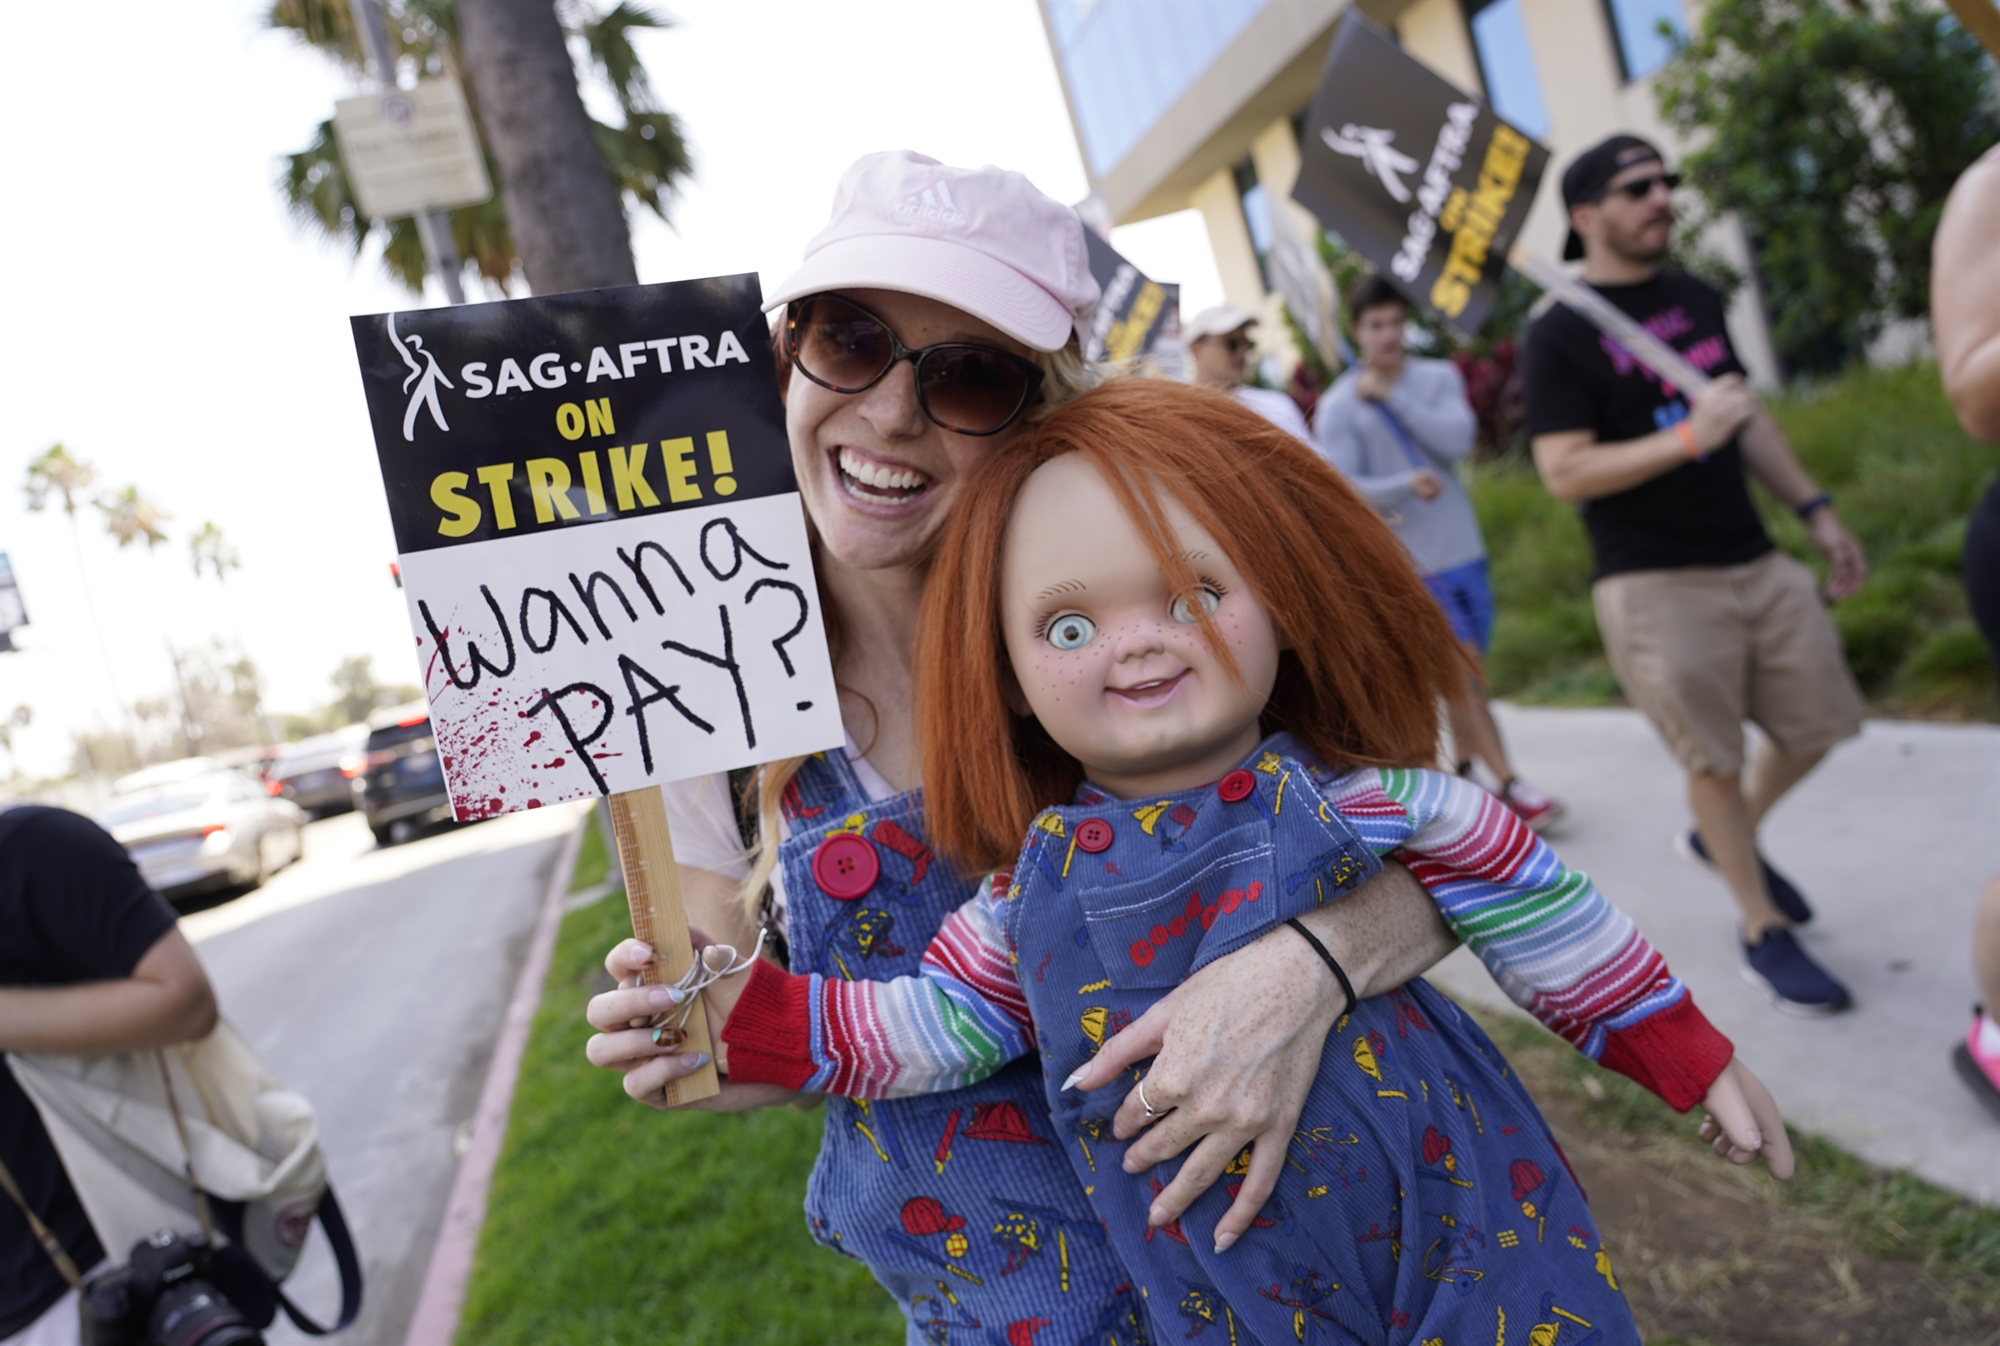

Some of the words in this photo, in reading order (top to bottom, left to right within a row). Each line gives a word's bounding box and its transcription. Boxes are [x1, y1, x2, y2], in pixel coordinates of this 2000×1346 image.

[896, 202, 967, 225] adidas
[1430, 123, 1531, 319] STRIKE!
[430, 430, 738, 538] STRIKE!
[556, 397, 616, 441] ON
[417, 517, 789, 690] Wanna
[526, 577, 814, 796] PAY?
